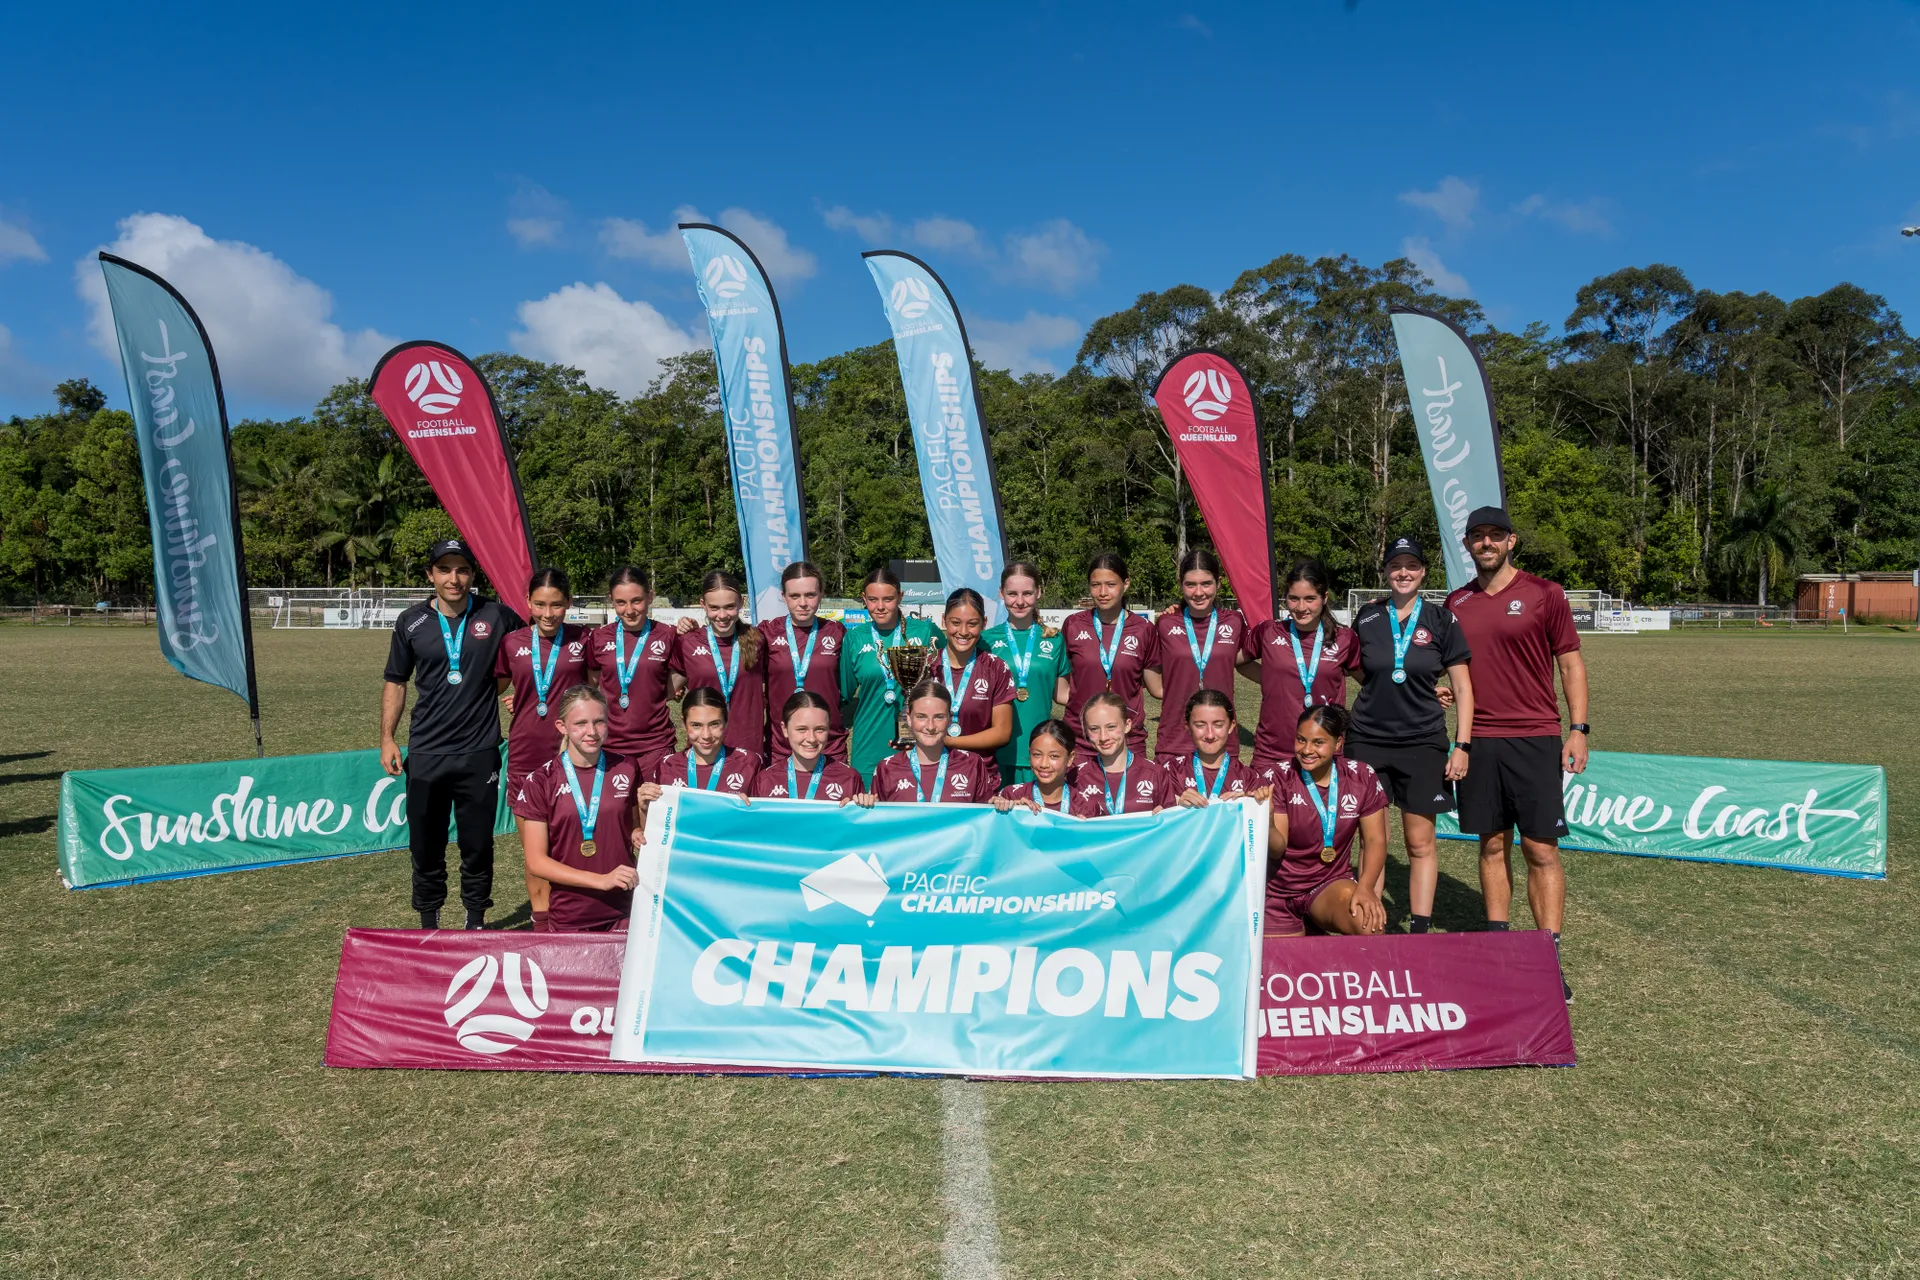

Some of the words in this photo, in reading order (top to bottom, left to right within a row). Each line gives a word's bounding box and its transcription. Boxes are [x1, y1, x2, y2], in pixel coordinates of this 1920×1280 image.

[896, 323, 943, 339] QUEENSLAND
[408, 426, 476, 438] QUEENSLAND
[417, 418, 465, 428] FOOTBALL
[1180, 433, 1237, 442] QUEENSLAND
[1188, 425, 1228, 434] FOOTBALL
[729, 407, 760, 500] PACIFIC
[744, 336, 791, 574] CHAMPIONSHIPS
[923, 420, 959, 510] PACIFIC
[931, 351, 993, 580] CHAMPIONSHIPS
[100, 775, 353, 861] Sunshine
[1683, 785, 1860, 843] Coast
[900, 891, 1116, 914] CHAMPIONSHIPS
[902, 871, 987, 894] PACIFIC
[648, 894, 659, 938] CHAMPIONS
[691, 939, 1223, 1021] CHAMPIONS
[634, 990, 645, 1035] CHAMPIONS
[1258, 1002, 1467, 1038] EENSLAND
